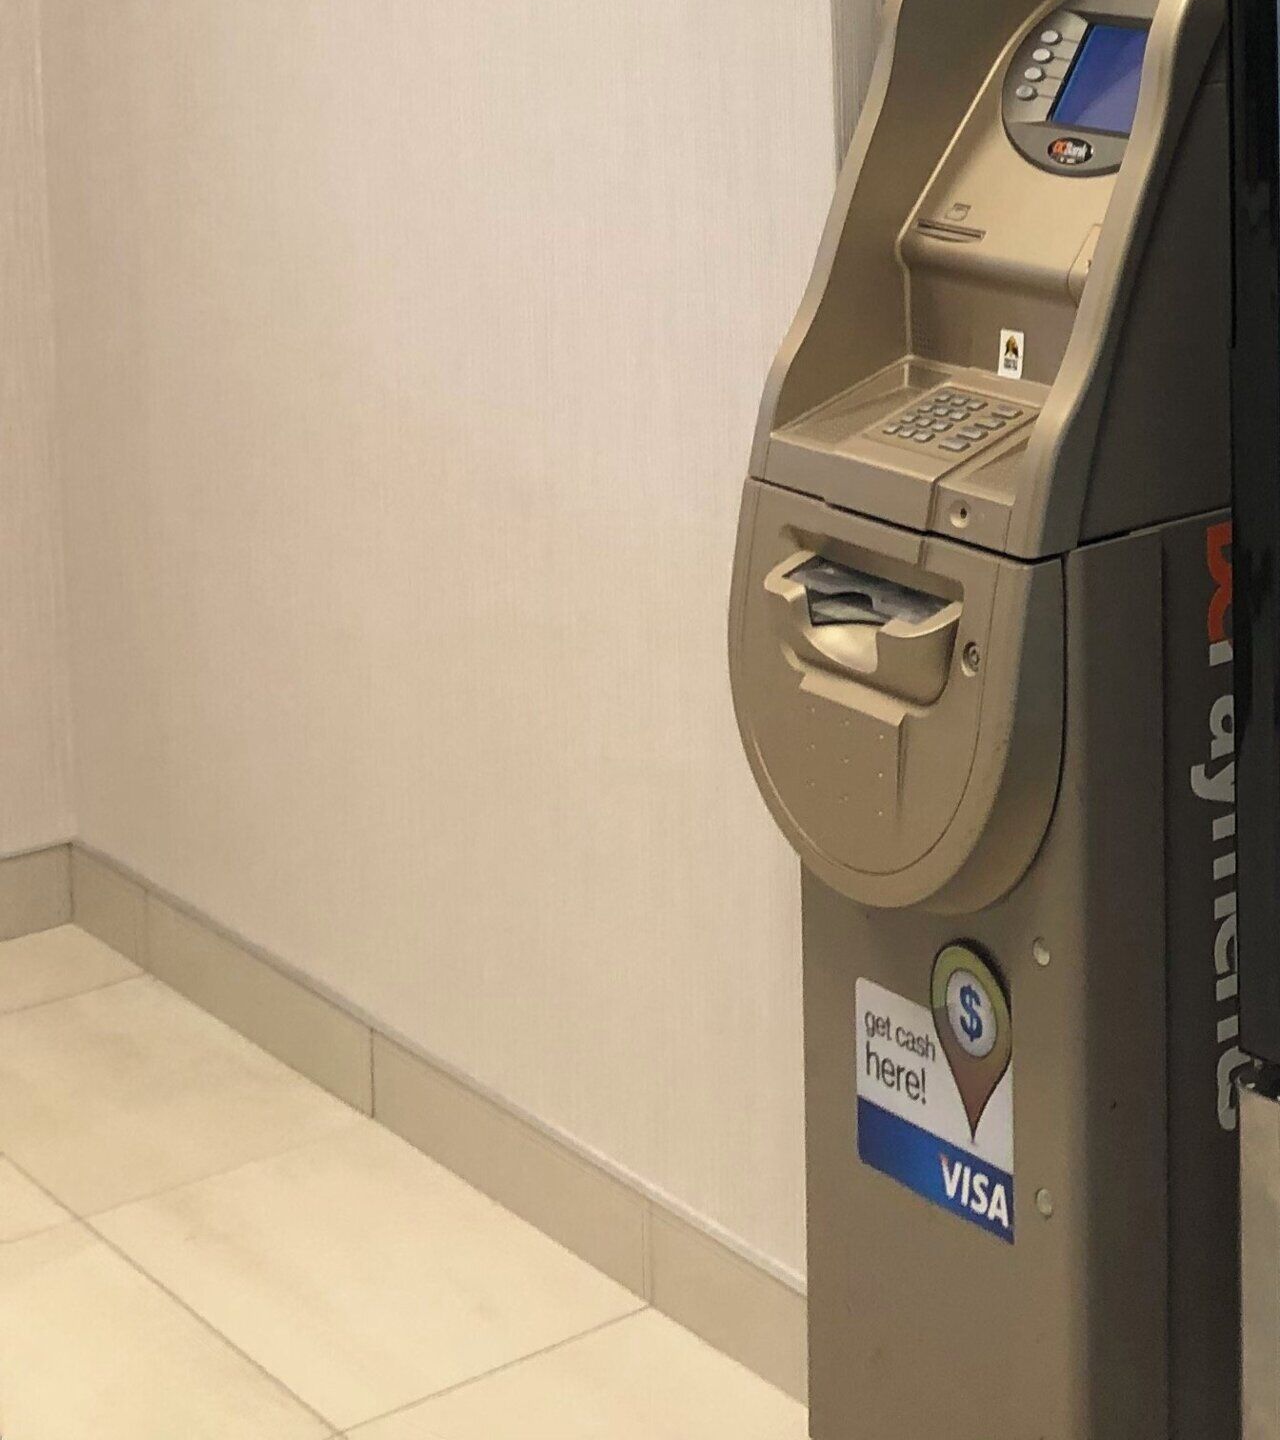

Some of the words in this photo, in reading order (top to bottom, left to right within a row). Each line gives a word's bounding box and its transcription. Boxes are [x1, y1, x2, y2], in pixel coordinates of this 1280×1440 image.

[864, 1010, 892, 1040] get
[896, 1026, 936, 1061] cash
[865, 1041, 926, 1105] here!
[940, 1154, 1009, 1228] VISA
